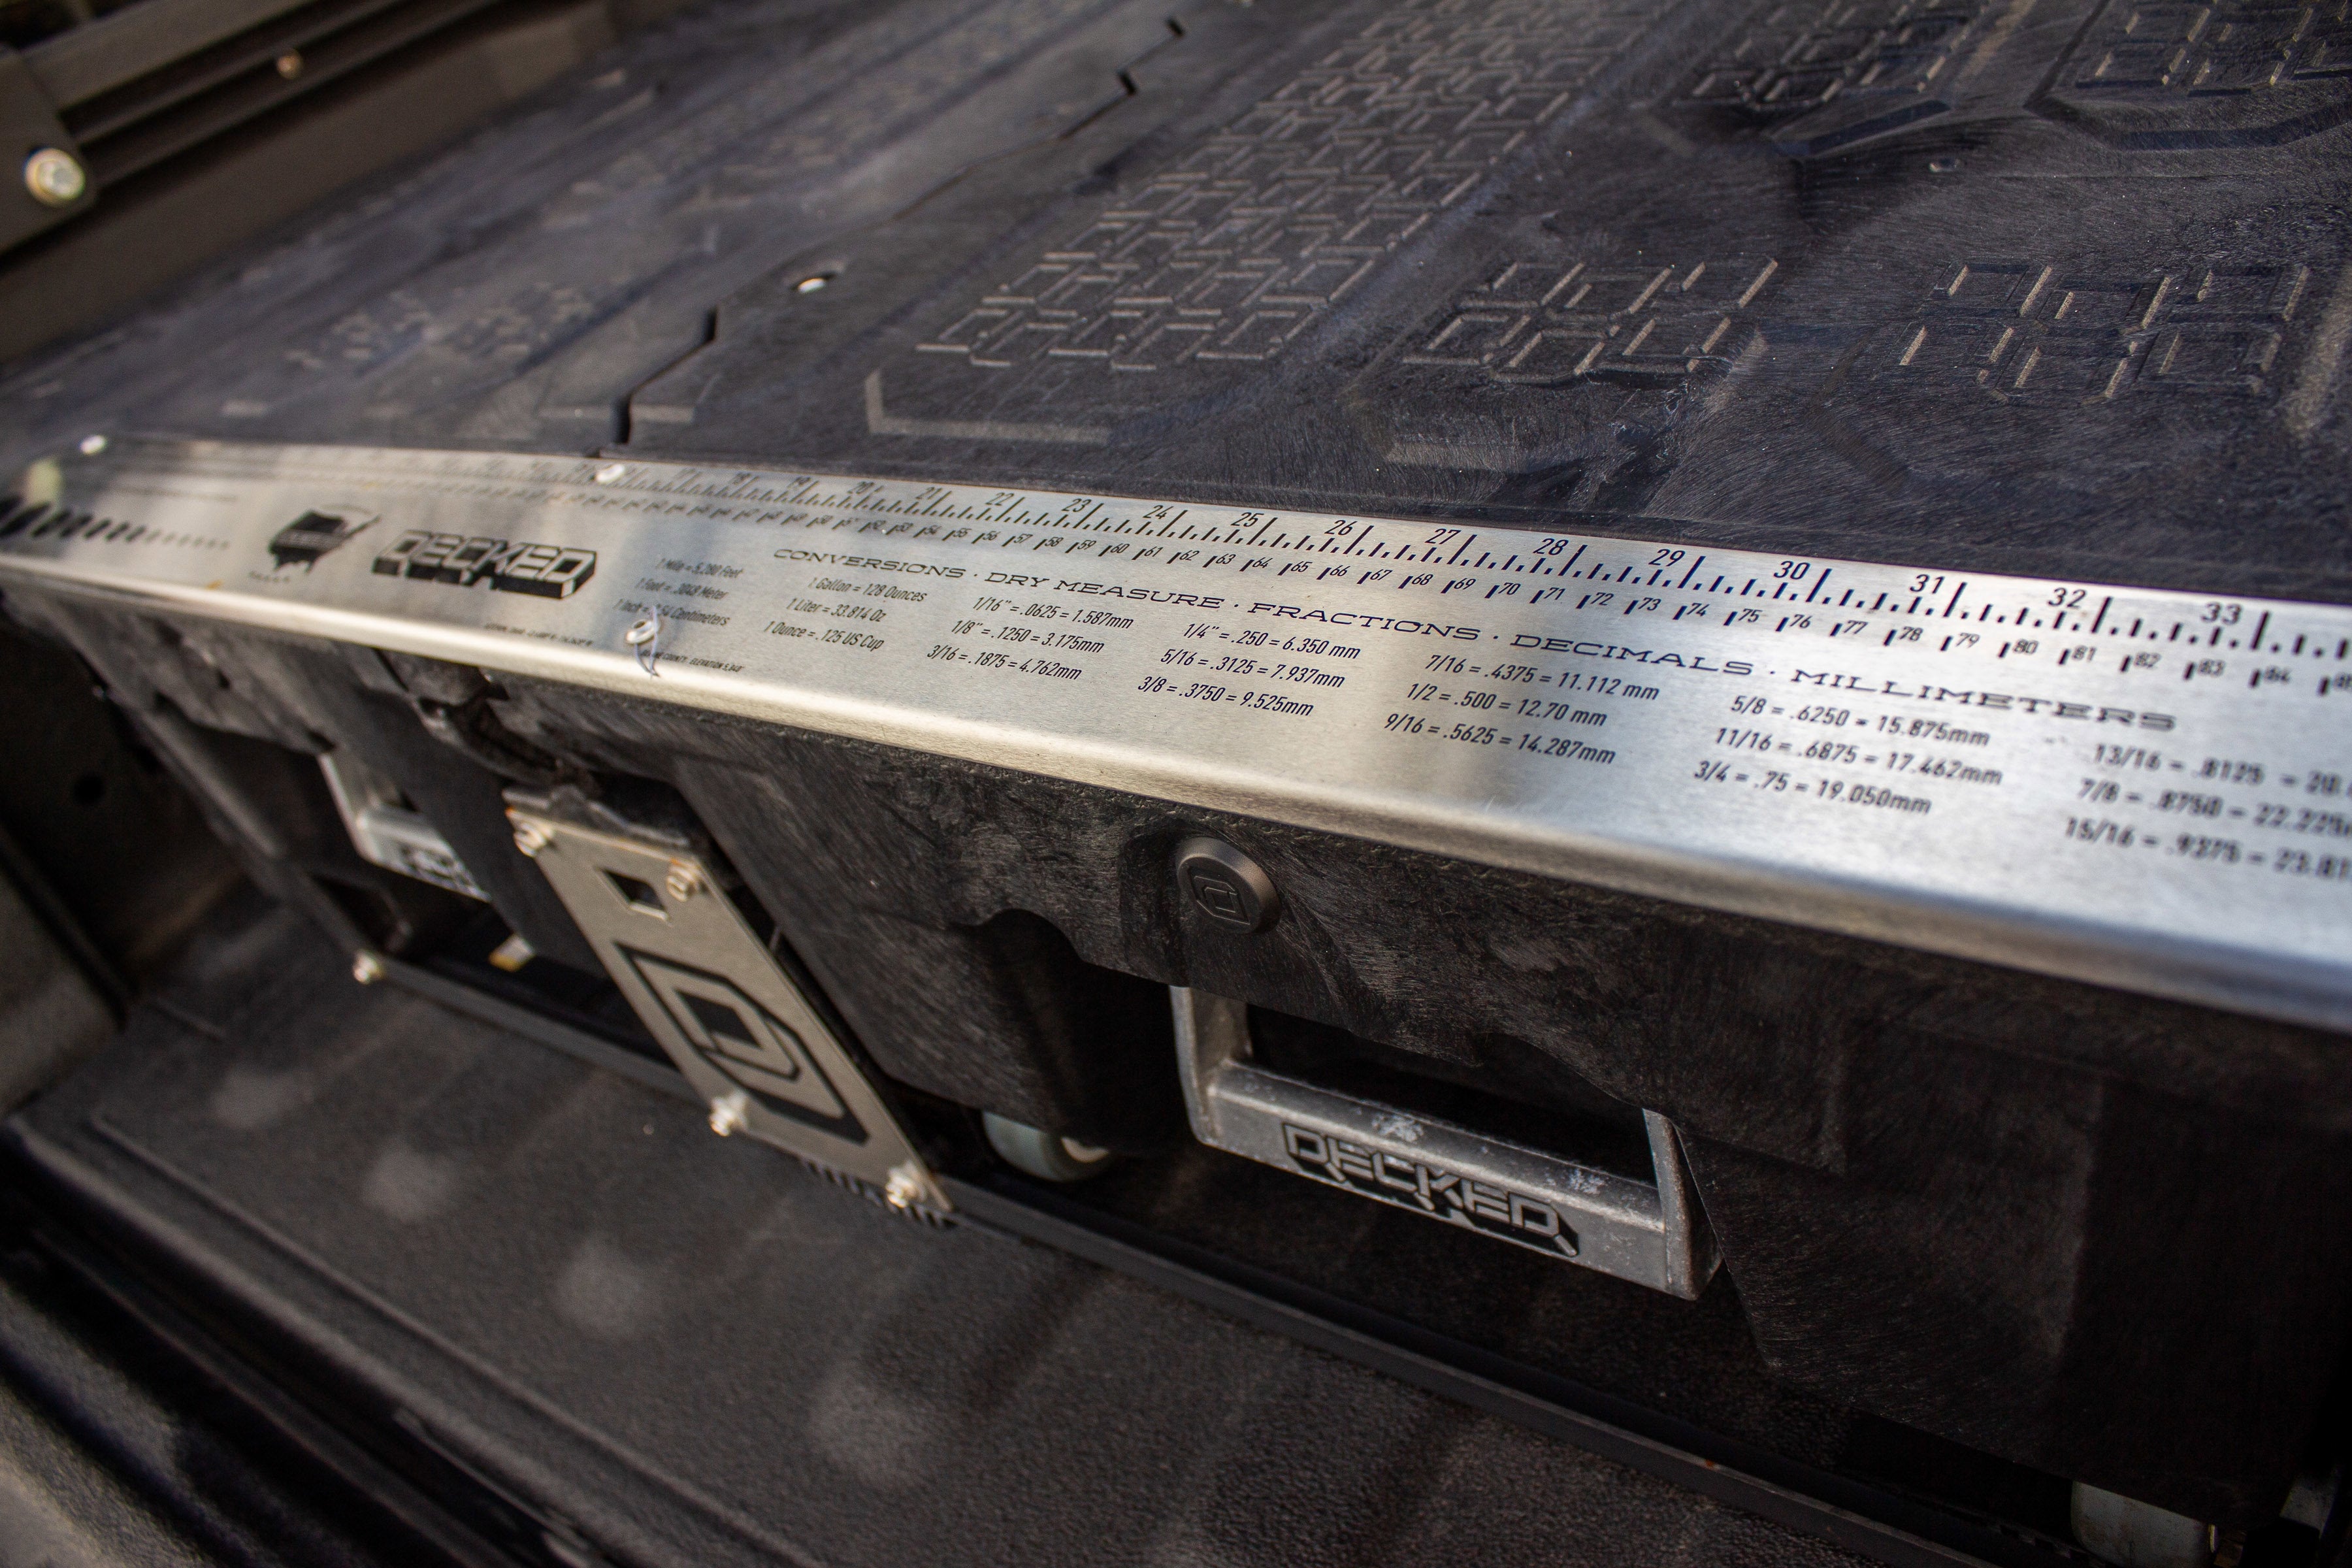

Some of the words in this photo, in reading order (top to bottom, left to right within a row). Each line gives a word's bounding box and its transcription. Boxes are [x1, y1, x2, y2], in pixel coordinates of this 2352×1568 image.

[371, 530, 596, 600] DECKED
[787, 477, 811, 487] 19
[848, 482, 874, 494] 20
[916, 487, 942, 499] 21
[986, 493, 1014, 506] 22
[1062, 498, 1092, 512] 23
[1143, 505, 1173, 519] 24
[1231, 512, 1264, 527] 25
[1324, 520, 1358, 535] 26
[1425, 529, 1462, 544] 27
[1533, 538, 1568, 555] 28
[1648, 549, 1686, 566] 29
[1773, 561, 1810, 580] 30
[1910, 574, 1946, 594] 31
[2048, 587, 2087, 609] 32
[2201, 602, 2243, 625] 33
[815, 578, 851, 591] Gallon
[862, 583, 887, 596] 128
[883, 585, 927, 601] Ounces
[925, 525, 942, 535] 54
[953, 528, 972, 538] 55
[983, 531, 1001, 540] 56
[1014, 534, 1033, 543] 57
[1045, 537, 1064, 547] 58
[1078, 540, 1096, 550] 59
[1111, 544, 1130, 553] 60
[1144, 547, 1163, 557] 61
[1179, 550, 1200, 561] 62
[1215, 554, 1236, 564] 63
[1252, 558, 1273, 568] 64
[1291, 561, 1313, 572] 65
[1330, 565, 1350, 576] 66
[1370, 569, 1392, 581] 67
[1412, 574, 1433, 585] 68
[1454, 578, 1476, 590] 69
[1498, 583, 1521, 595] 70
[1543, 588, 1565, 600] 71
[1590, 593, 1614, 606] 72
[1638, 597, 1661, 611] 73
[1686, 602, 1710, 617] 74
[1738, 608, 1763, 622] 75
[1789, 614, 1812, 629] 76
[1844, 621, 1869, 634] 77
[1899, 626, 1923, 642] 78
[1956, 632, 1980, 648] 79
[2013, 639, 2039, 655] 80
[2072, 645, 2098, 662] 81
[2134, 652, 2161, 669] 82
[2198, 659, 2225, 677] 83
[670, 608, 730, 626] Centimeters
[787, 598, 796, 609] 1
[793, 599, 822, 612] Liter
[830, 604, 872, 619] 33.814
[869, 609, 886, 621] Oz
[1020, 603, 1060, 618] .0625
[1071, 609, 1134, 629] 1.587mm
[764, 621, 774, 631] 1
[772, 622, 806, 637] Ounce
[815, 629, 845, 642] .125
[841, 632, 862, 645] US
[859, 635, 884, 651] Cup
[774, 549, 966, 578] CONVERSIONS
[985, 572, 1050, 587] DRY
[1054, 580, 1224, 608] MEASURE
[1247, 602, 1480, 640] FRACTIONS
[1510, 634, 1754, 675] DECIMALS
[1791, 668, 2176, 731] MILLIMETERS
[991, 627, 1031, 642] .1250
[1041, 632, 1104, 653] 3.175mm
[1231, 630, 1268, 645] .250
[1282, 636, 1329, 654] 6.350
[1328, 645, 1360, 659] mm
[927, 645, 959, 660] 3/16
[968, 652, 1009, 667] .1875
[1019, 659, 1081, 679] 4.762mm
[1160, 649, 1197, 665] 5/16
[1210, 657, 1257, 674] .3125
[1270, 664, 1345, 687] 7.937mm
[1425, 655, 1466, 673] 7/16
[1484, 664, 1537, 682] .4375
[1558, 672, 1621, 694] 11.112
[1622, 685, 1659, 700] mm
[1137, 676, 1166, 692] 3/8
[1179, 683, 1225, 701] .3750
[1239, 691, 1313, 715] 9.525mm
[1407, 683, 1437, 700] 1/2
[1454, 691, 1496, 709] .500
[1518, 698, 1569, 720] 12.70
[1570, 710, 1607, 726] mm
[1384, 713, 1425, 733] 9/16
[1443, 723, 1497, 744] .5625
[1518, 734, 1615, 763] 14.287mm
[1731, 695, 1767, 714] 5/8
[1790, 706, 1850, 726] .6250
[1878, 715, 1989, 745] 15.875mm
[1715, 728, 1772, 751] 11/16
[1797, 741, 1859, 763] .6875
[1887, 752, 2003, 785] 17.462mm
[2094, 743, 2161, 770] 13/16
[1694, 760, 1730, 782] 3/4
[1754, 771, 1789, 791] .75
[1795, 783, 1807, 791] =
[1818, 779, 1931, 813] 19.050mm
[2077, 778, 2119, 803] 7/8
[2065, 817, 2134, 848] 15/16
